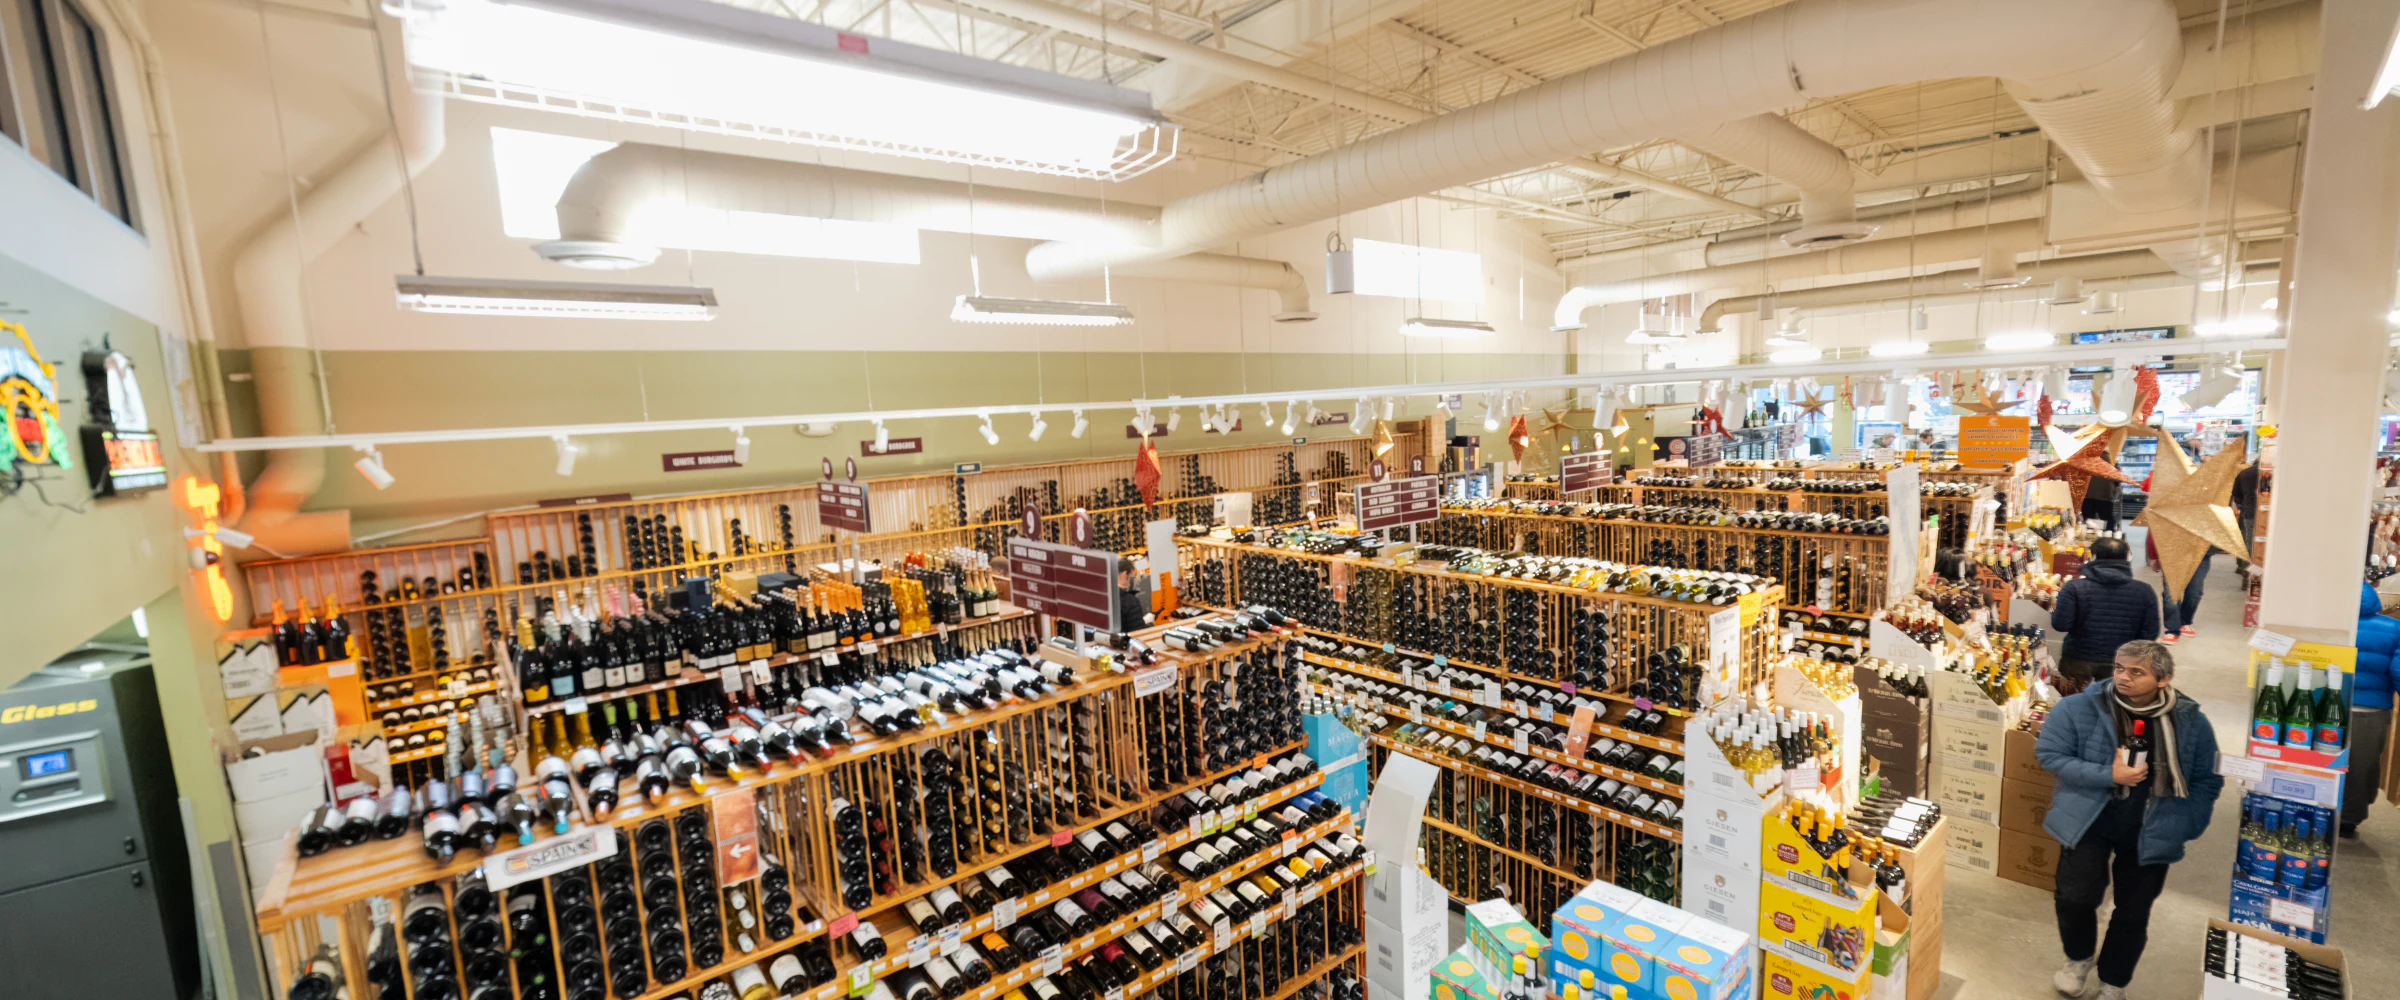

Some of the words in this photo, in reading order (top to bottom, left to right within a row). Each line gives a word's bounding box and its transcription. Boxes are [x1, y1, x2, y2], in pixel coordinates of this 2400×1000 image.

[1374, 464, 1382, 478] 11
[1413, 460, 1422, 472] 12
[1027, 510, 1035, 534] 9
[1076, 516, 1085, 542] 8
[1071, 554, 1086, 568] SPAIN
[1, 698, 98, 724] Glass
[1706, 818, 1738, 834] GIESEN
[530, 843, 577, 868] SPAIN
[1704, 884, 1736, 900] GIESEN
[2232, 918, 2275, 932] CASAL
